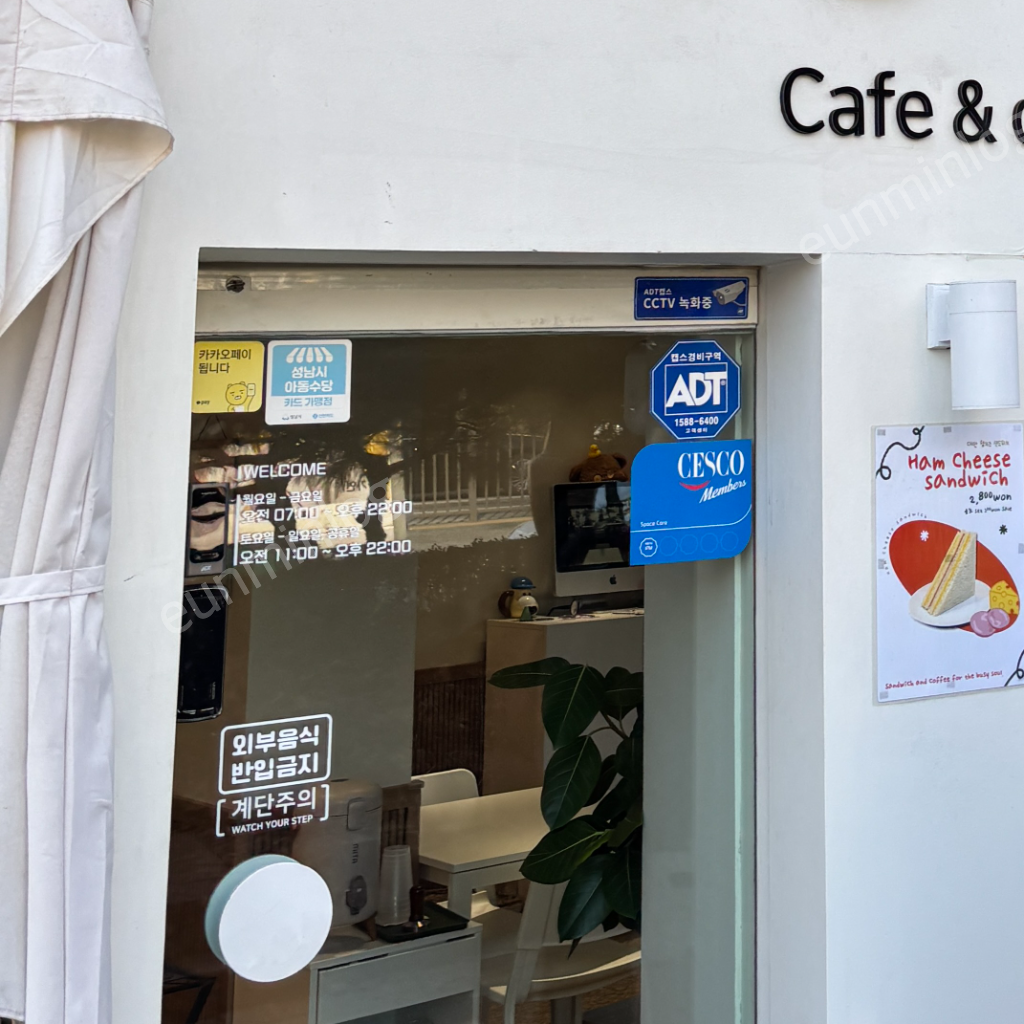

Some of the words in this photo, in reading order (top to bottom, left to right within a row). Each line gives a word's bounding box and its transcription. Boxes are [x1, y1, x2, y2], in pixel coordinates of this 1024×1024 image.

[780, 67, 934, 141] Cafe
[953, 79, 998, 144] &
[643, 297, 676, 309] CCTV
[678, 296, 713, 310] 녹화중
[198, 349, 252, 361] 카카오페이
[670, 352, 722, 363] 캡스경비구역
[198, 362, 231, 375] 됩니다
[291, 365, 328, 379] 성남시
[284, 379, 334, 393] 아동수당
[665, 371, 728, 409] ADT
[284, 397, 303, 407] 카드
[304, 396, 333, 407] 가맹점
[674, 416, 719, 427] 1588-6400
[677, 449, 746, 479] CESCO
[908, 454, 945, 471] Ham
[952, 451, 1011, 470] Cheese
[243, 462, 326, 479] WELCOME
[242, 492, 276, 505] 월요일
[289, 490, 323, 503] 금요일
[699, 478, 747, 504] Members
[241, 508, 269, 523] 오전
[336, 503, 364, 518] 오후
[367, 501, 413, 516] 22:00
[240, 531, 275, 545] 토요일
[239, 549, 268, 564] 오전
[275, 546, 318, 562] 11:00
[335, 543, 362, 557] 오후
[366, 540, 411, 555] 22:00
[231, 724, 320, 756] 외부음식
[231, 752, 318, 785] 반입금지
[231, 787, 316, 819] 계단주의
[231, 822, 264, 835] WATCH
[265, 818, 290, 829] YOUR
[291, 814, 314, 825] STEP
